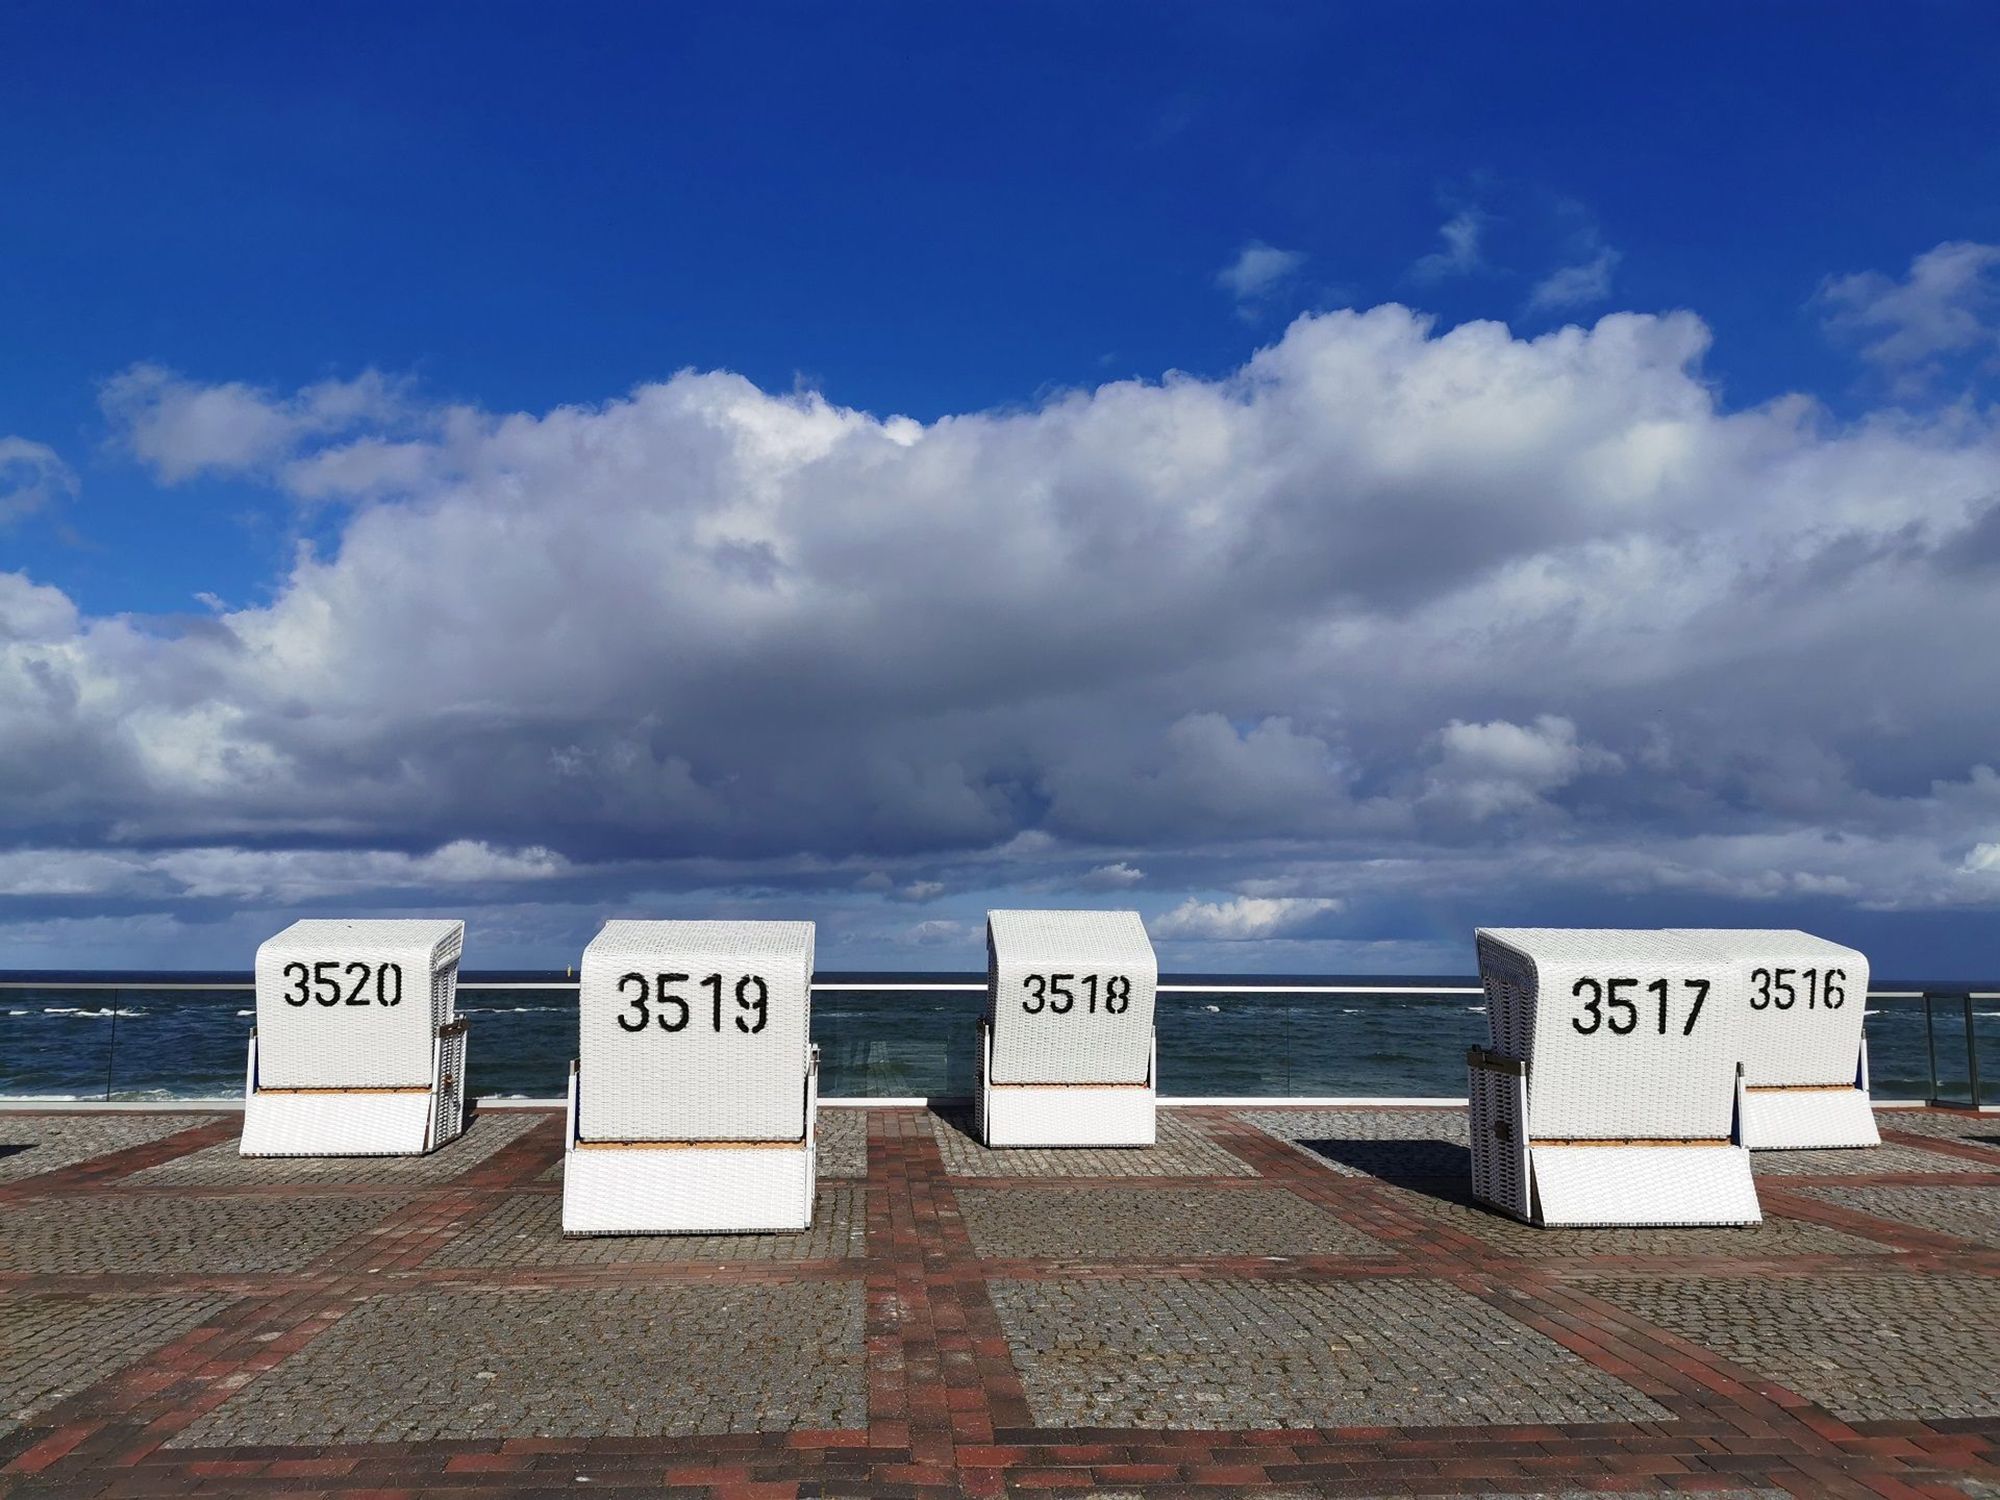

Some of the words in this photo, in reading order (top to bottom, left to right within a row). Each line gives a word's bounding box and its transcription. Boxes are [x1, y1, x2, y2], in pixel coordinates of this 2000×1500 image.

[283, 961, 403, 1008] 3520
[617, 971, 769, 1034] 3519
[1022, 973, 1132, 1015] 3518
[1571, 976, 1711, 1036] 3517
[1749, 967, 1847, 1011] 3516
